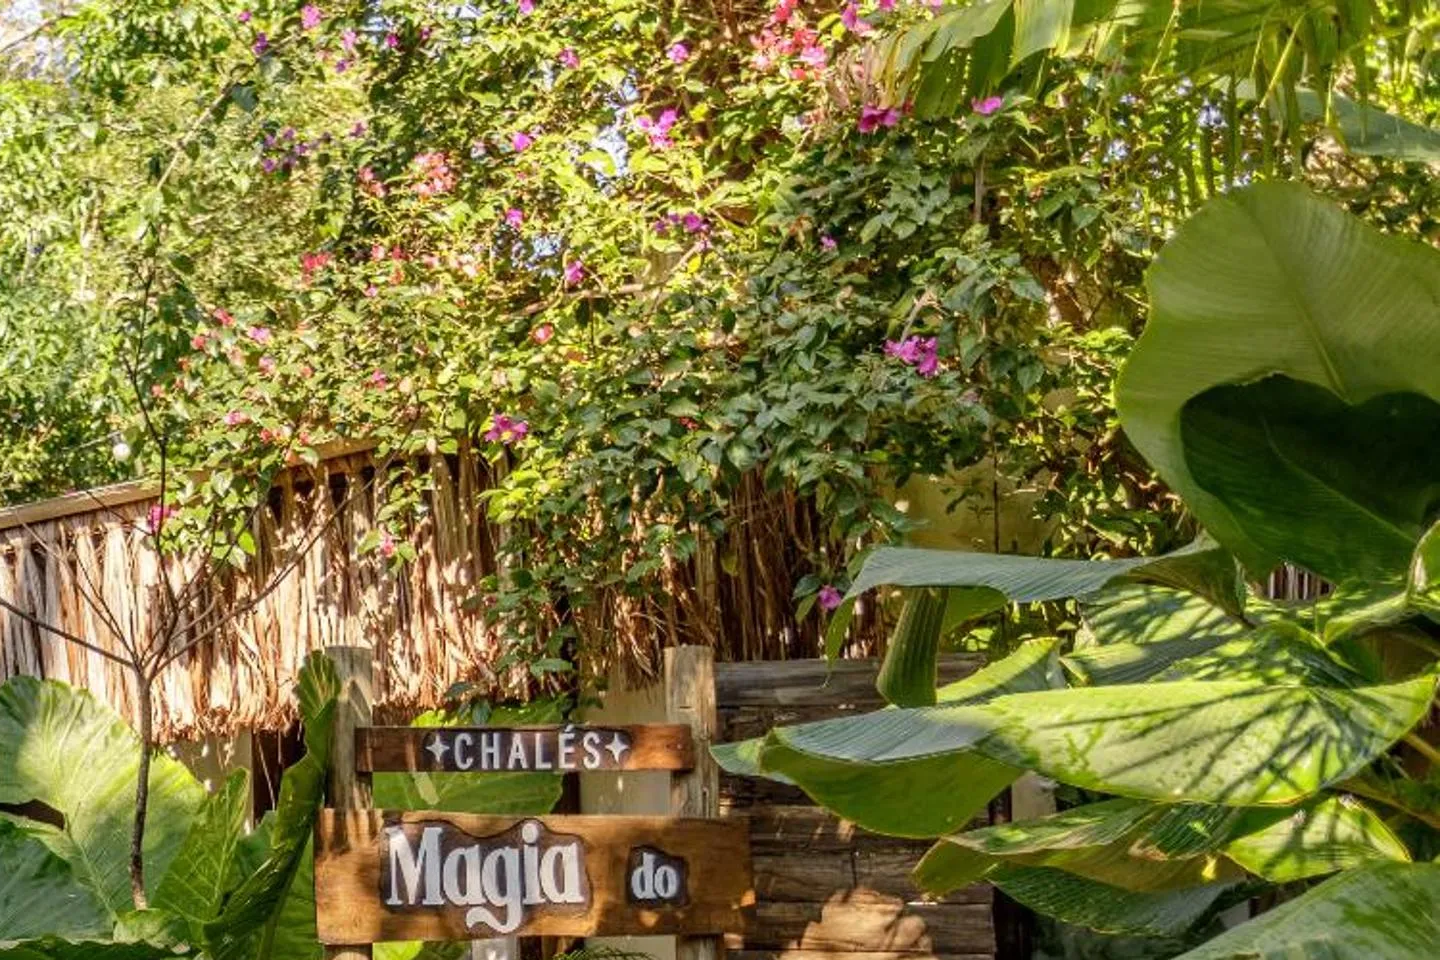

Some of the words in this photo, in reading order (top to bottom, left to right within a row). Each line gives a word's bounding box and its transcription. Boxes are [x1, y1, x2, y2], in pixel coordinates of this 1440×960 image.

[453, 725, 602, 771] CHALÉS
[385, 822, 586, 933] Magia
[631, 852, 677, 900] do
